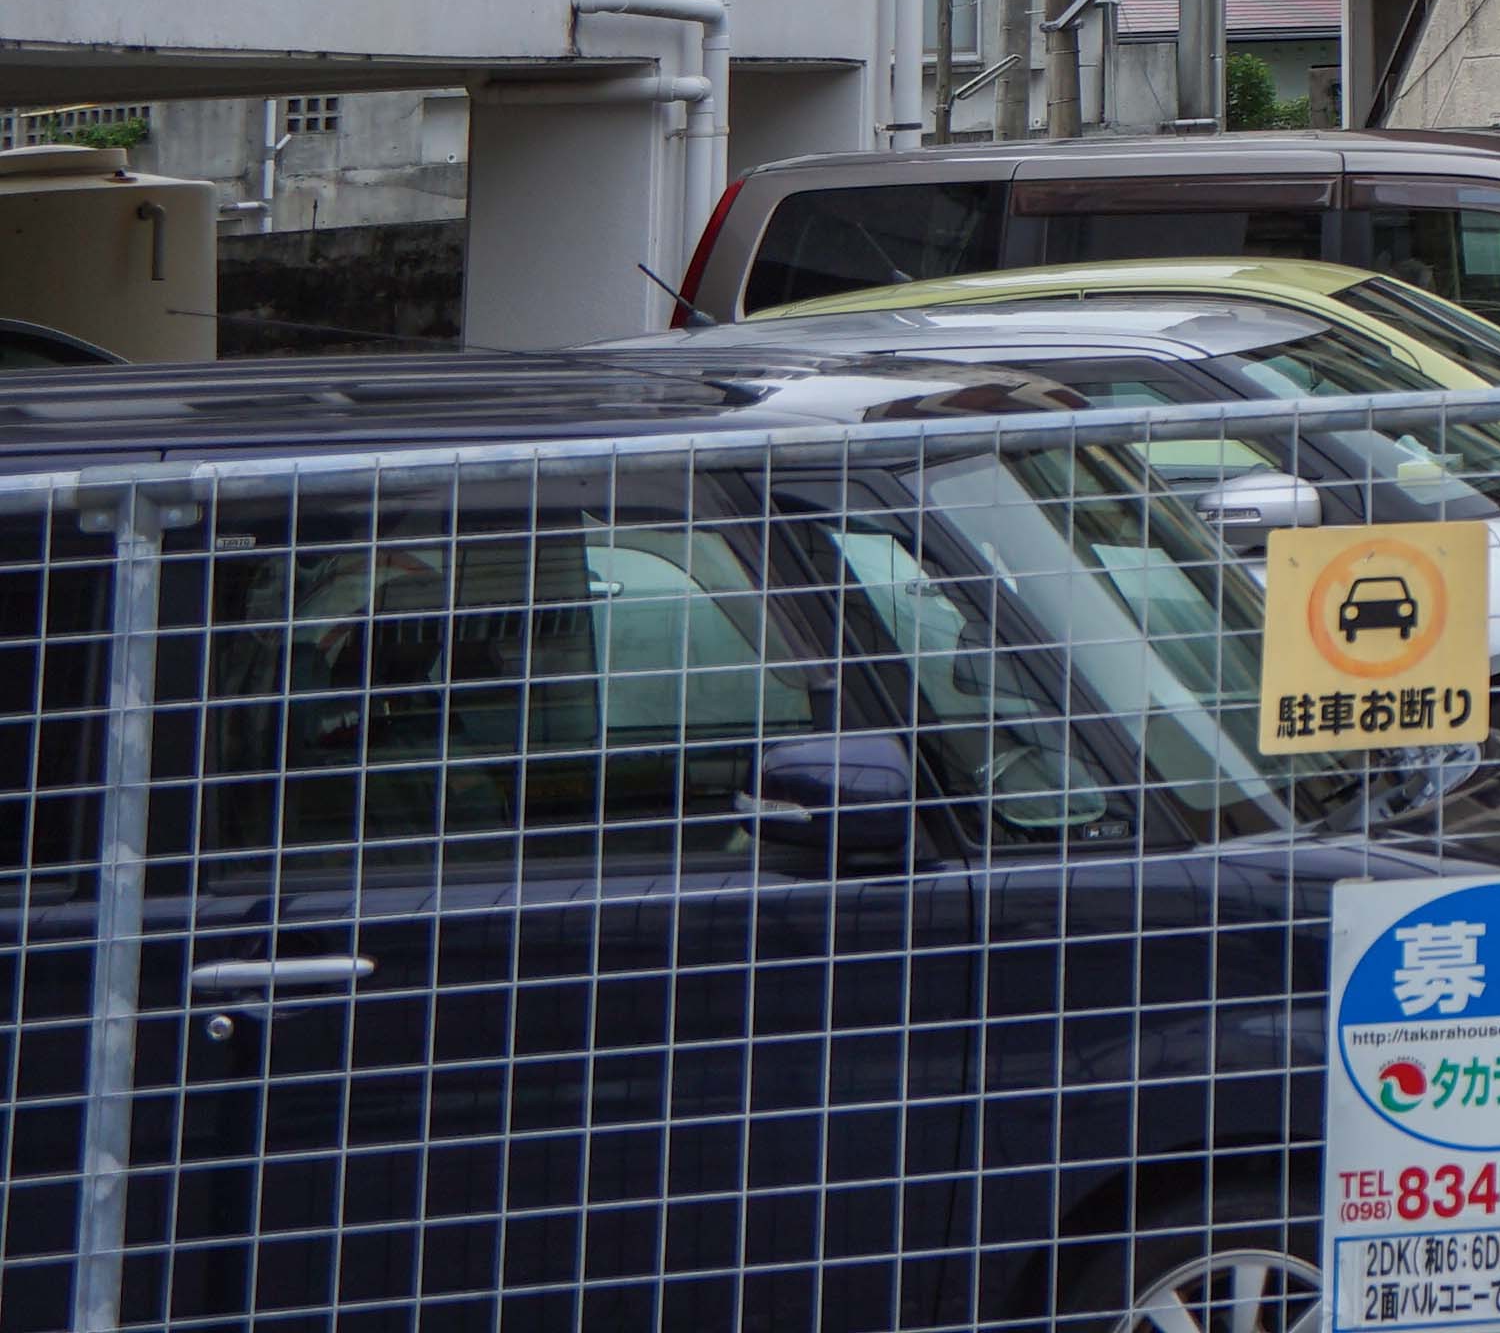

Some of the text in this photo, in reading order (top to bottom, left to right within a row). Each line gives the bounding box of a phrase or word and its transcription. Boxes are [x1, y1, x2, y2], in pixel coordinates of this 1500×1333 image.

[1277, 686, 1472, 737] 駐車お断り
[1339, 1170, 1393, 1199] TEL
[1339, 1199, 1393, 1223] (098)
